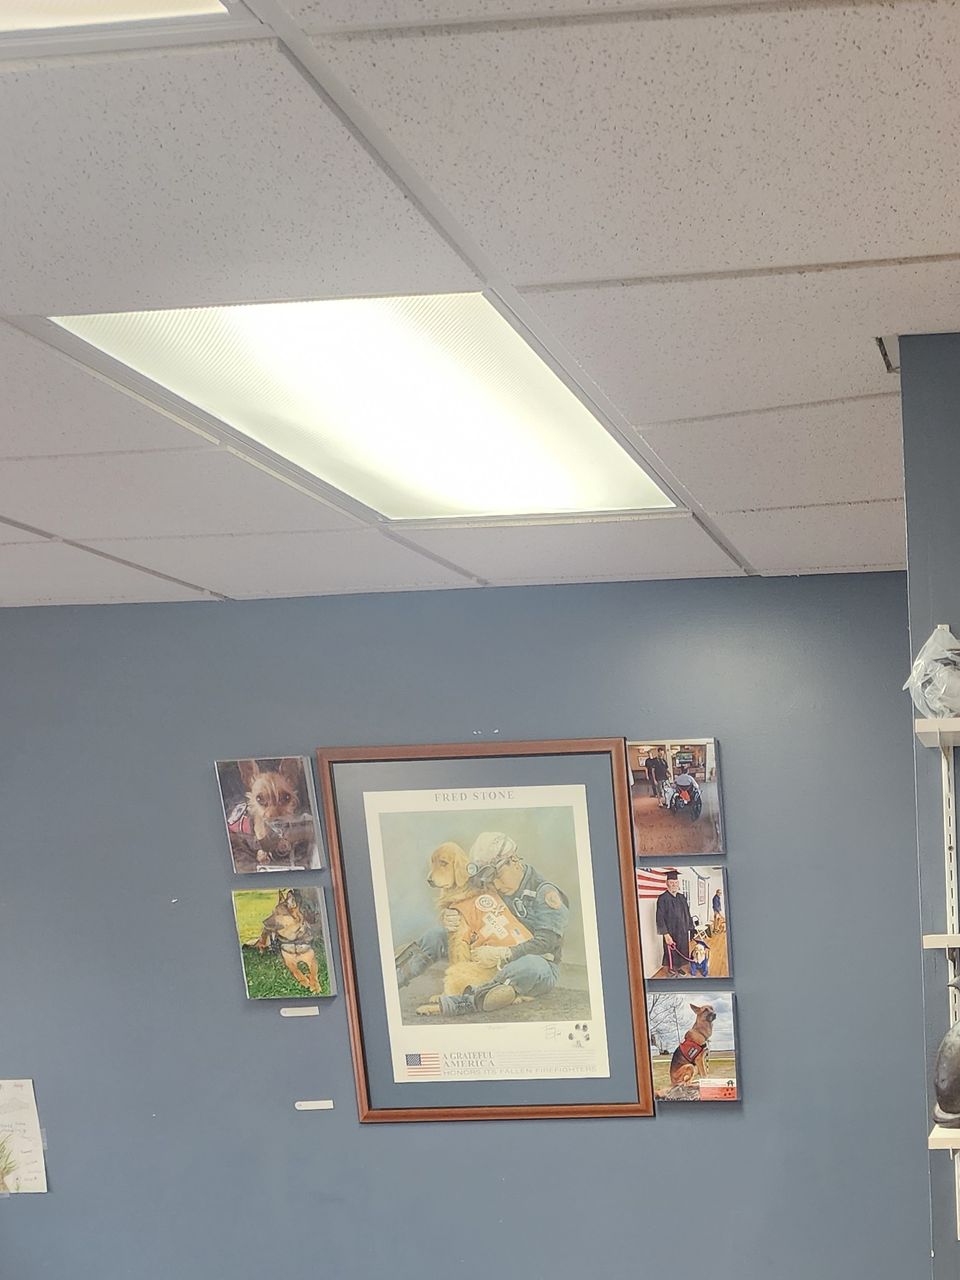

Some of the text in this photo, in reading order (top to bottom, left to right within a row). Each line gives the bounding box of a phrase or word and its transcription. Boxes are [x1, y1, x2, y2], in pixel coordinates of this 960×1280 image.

[434, 790, 514, 802] FRED STONE
[442, 1052, 449, 1060] A
[450, 1051, 494, 1060] GRATEFUL
[442, 1060, 495, 1068] AMERICA
